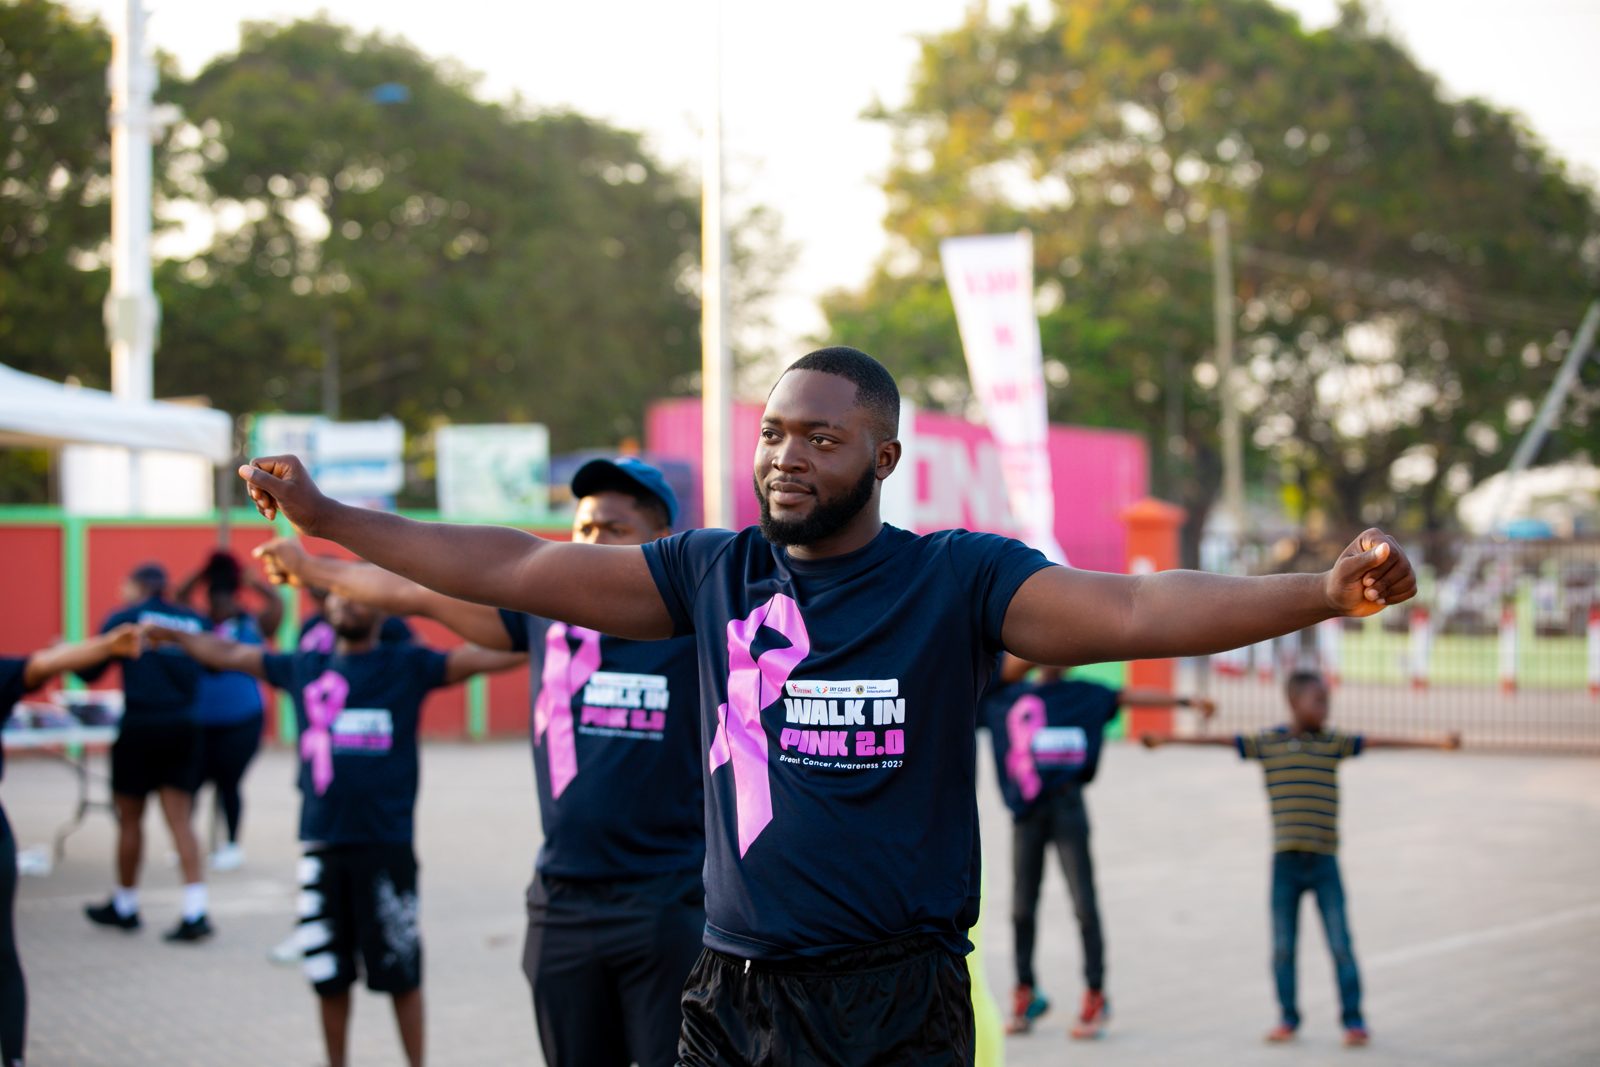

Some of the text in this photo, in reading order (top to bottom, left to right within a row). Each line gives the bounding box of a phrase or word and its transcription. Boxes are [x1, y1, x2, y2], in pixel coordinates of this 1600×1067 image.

[783, 698, 906, 726] WALK IN
[780, 727, 905, 757] PINK 2.0
[802, 757, 832, 768] Cancer
[833, 761, 879, 770] Awareness
[881, 760, 904, 769] 2023
